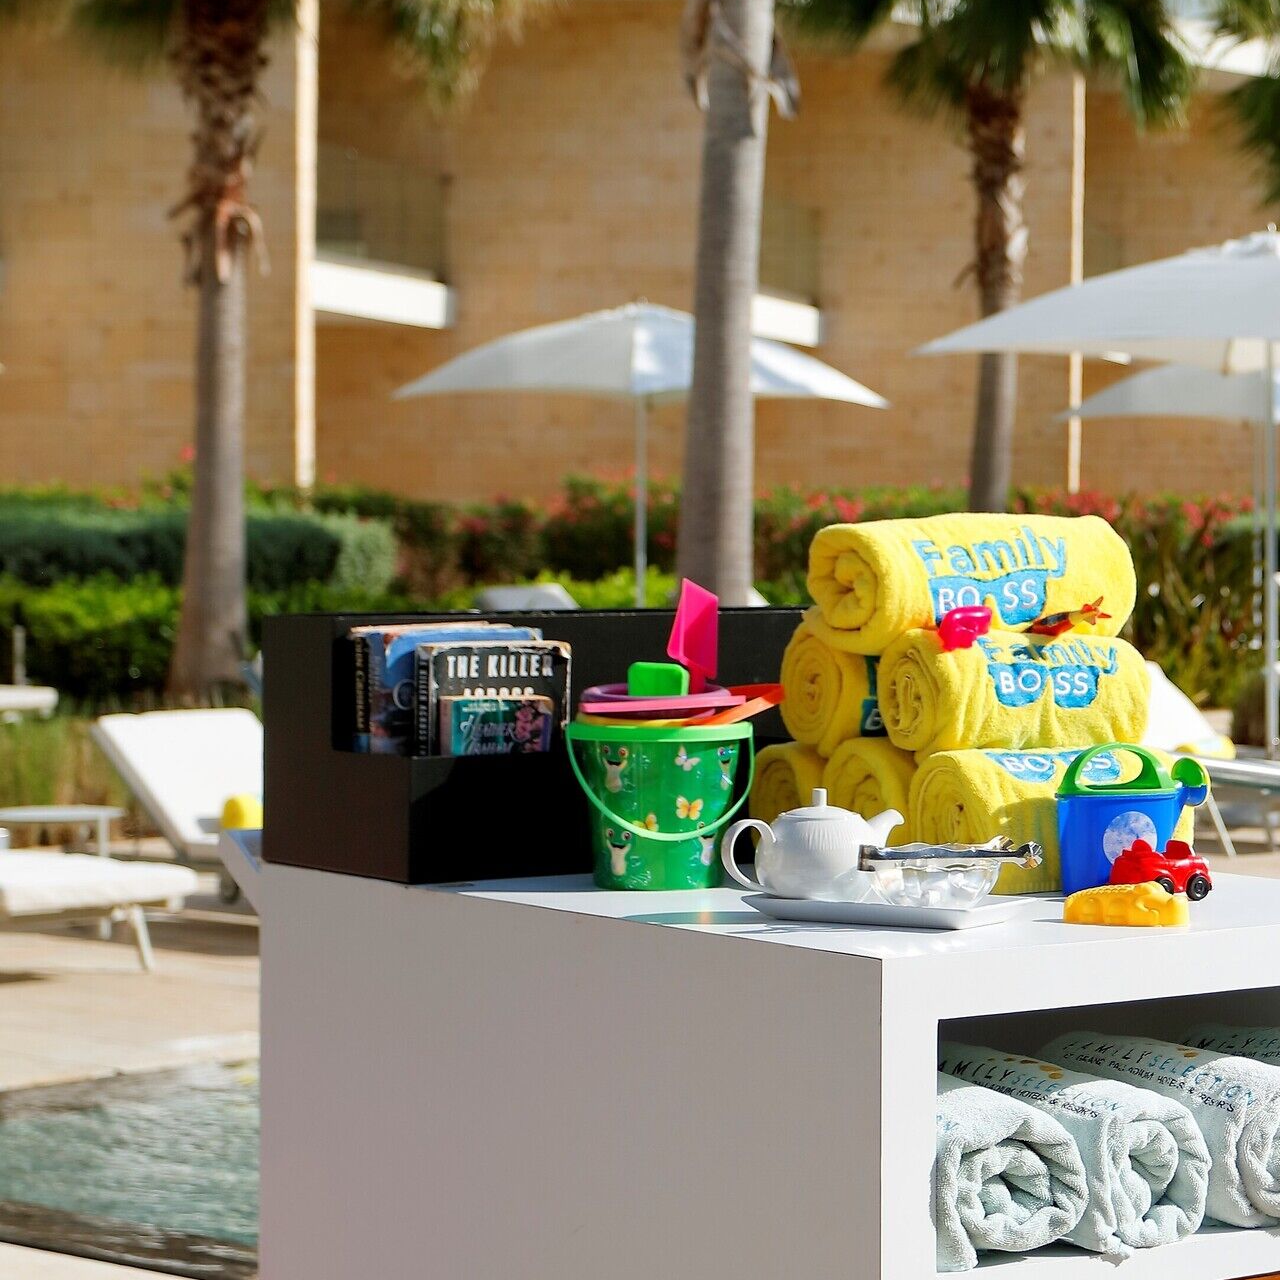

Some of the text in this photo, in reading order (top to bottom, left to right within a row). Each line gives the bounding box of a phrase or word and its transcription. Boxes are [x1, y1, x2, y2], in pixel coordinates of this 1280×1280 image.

[911, 525, 1067, 578] Family
[938, 579, 1038, 614] BOSS
[447, 654, 554, 679] THE KILLER
[1000, 667, 1090, 697] BOSS
